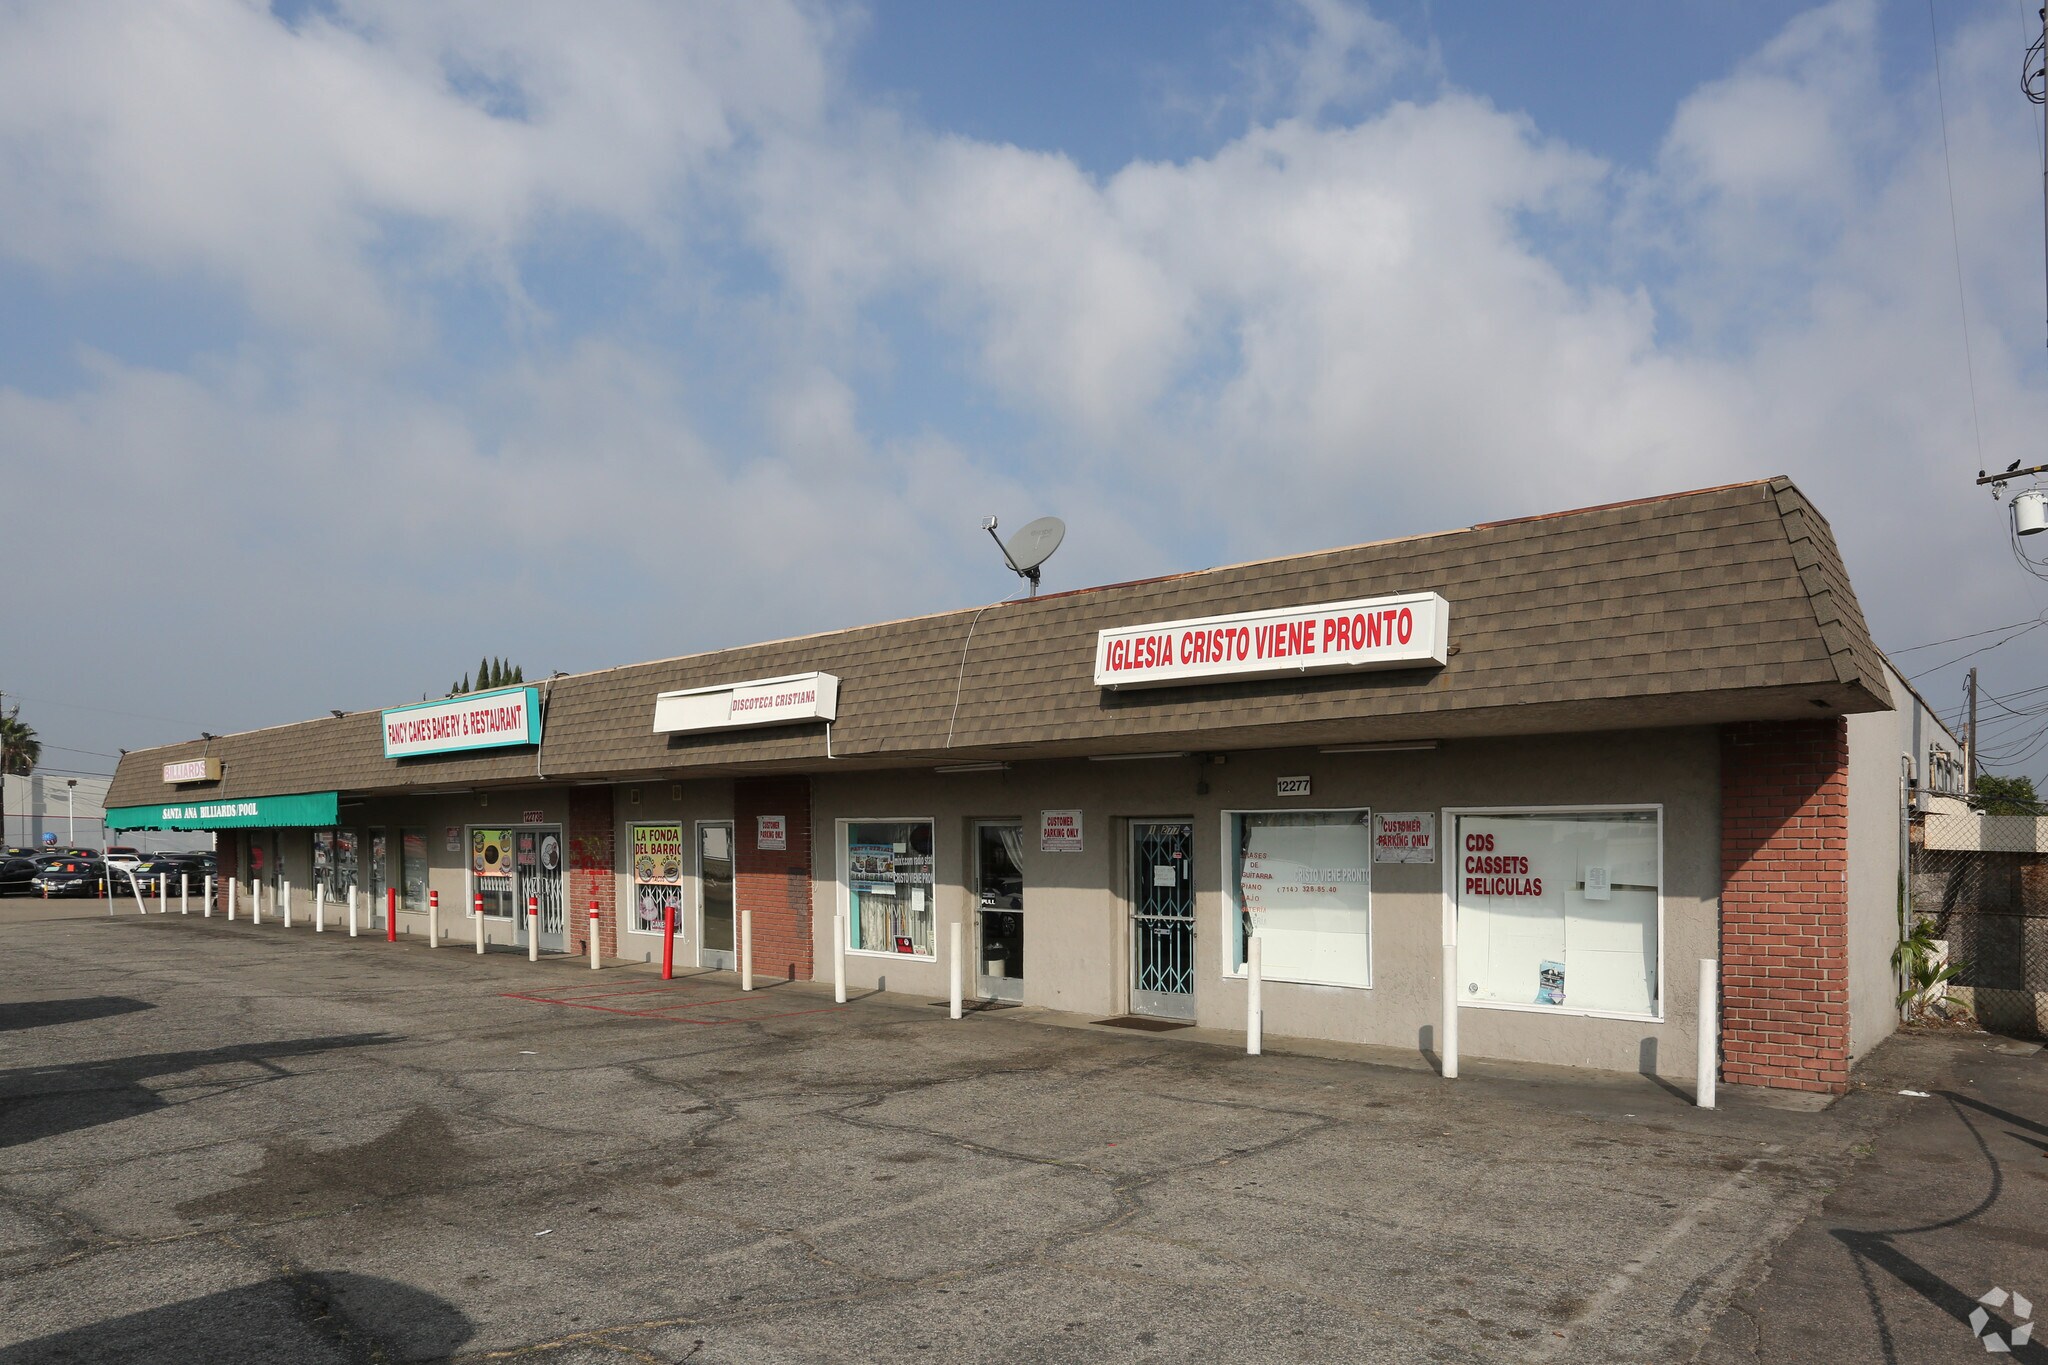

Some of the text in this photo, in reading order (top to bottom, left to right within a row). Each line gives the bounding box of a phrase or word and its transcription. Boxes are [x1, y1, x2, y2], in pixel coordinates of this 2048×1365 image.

[1105, 607, 1413, 672] IGLESIA CRISTO VIENE PRONTO
[732, 689, 815, 712] DISCOTECA CRISTIANA
[388, 723, 408, 745] FANCY
[408, 718, 432, 743] CAKE'S
[463, 712, 469, 736] &
[470, 704, 522, 735] RESTAURANT
[163, 760, 206, 780] BILLIARDS
[1277, 780, 1310, 792] 12277
[162, 807, 182, 820] SANTA
[184, 807, 198, 819] ANA
[1047, 816, 1074, 827] CUSTOMER
[1383, 820, 1421, 833] CUSTOMER
[636, 829, 679, 842] LA FONDA
[1044, 828, 1079, 838] PARKING ONLY
[1378, 834, 1430, 847] PARKING ONLY
[1465, 833, 1495, 852] CDS
[635, 843, 648, 855] DEL
[1250, 861, 1259, 869] DE
[1465, 856, 1529, 875] CASSETS
[1241, 871, 1273, 881] GUITARRA
[1319, 868, 1341, 882] VIENE
[1241, 883, 1262, 892] PIANO
[1466, 877, 1543, 897] PELICULAS
